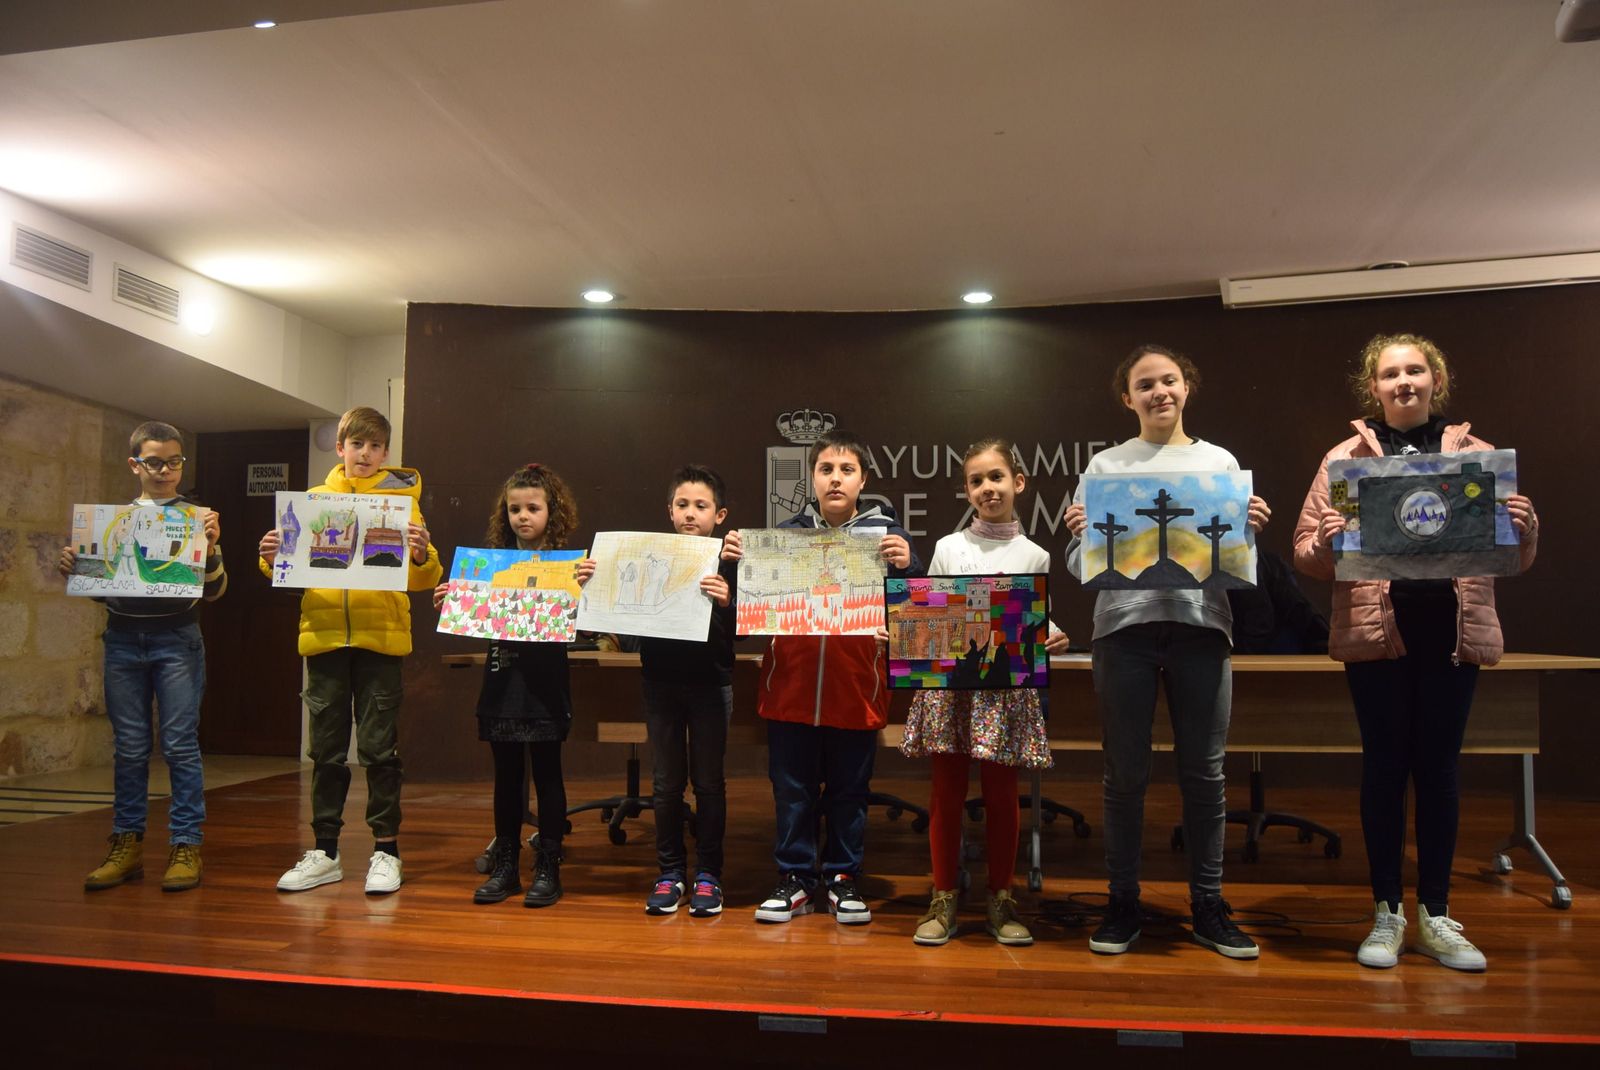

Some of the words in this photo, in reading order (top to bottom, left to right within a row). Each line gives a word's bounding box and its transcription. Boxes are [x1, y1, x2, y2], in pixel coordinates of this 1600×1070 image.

[252, 466, 284, 479] PERSONAL
[248, 481, 287, 494] AUTORIZADO
[71, 578, 137, 592] SEMANA
[145, 584, 193, 596] SANTA
